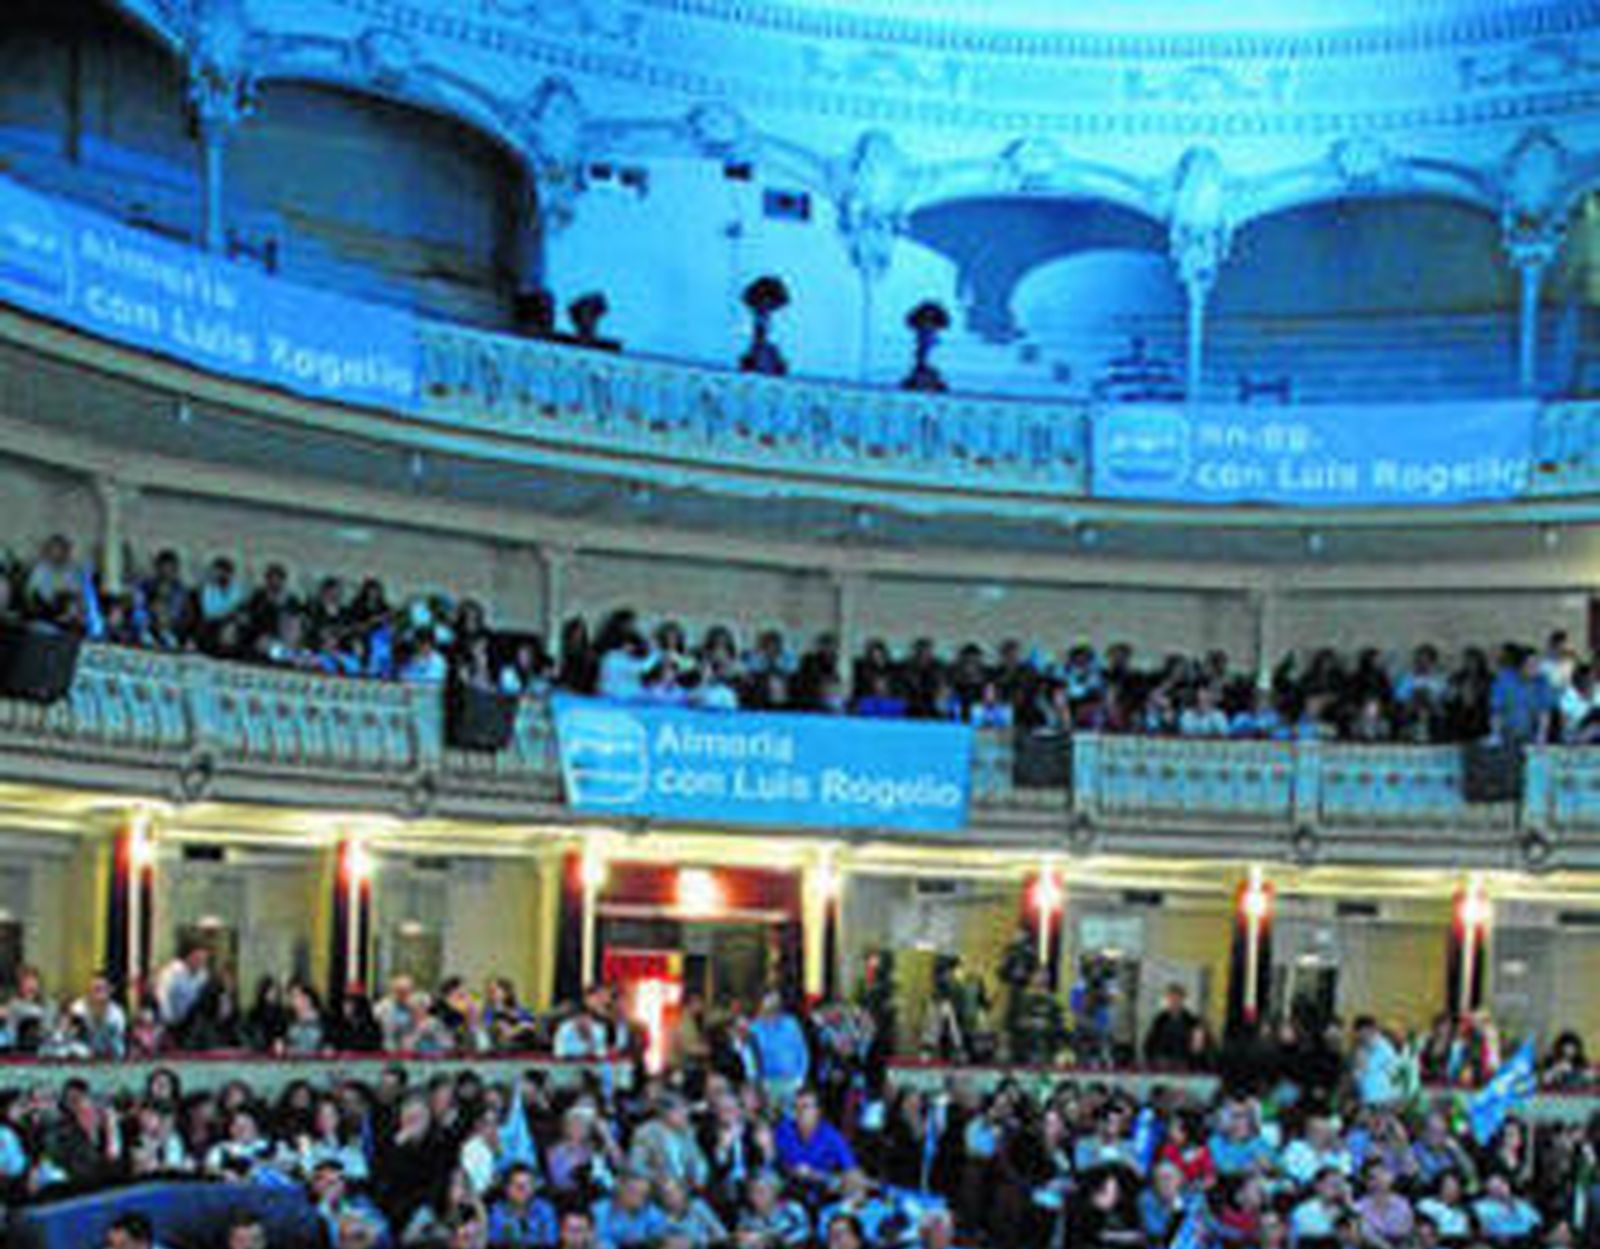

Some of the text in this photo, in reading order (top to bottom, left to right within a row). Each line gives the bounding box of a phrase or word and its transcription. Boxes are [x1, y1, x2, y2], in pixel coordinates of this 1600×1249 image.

[1196, 461, 1265, 490] con
[1278, 459, 1358, 491] Luis
[657, 768, 963, 807] con Luis Rogelio
